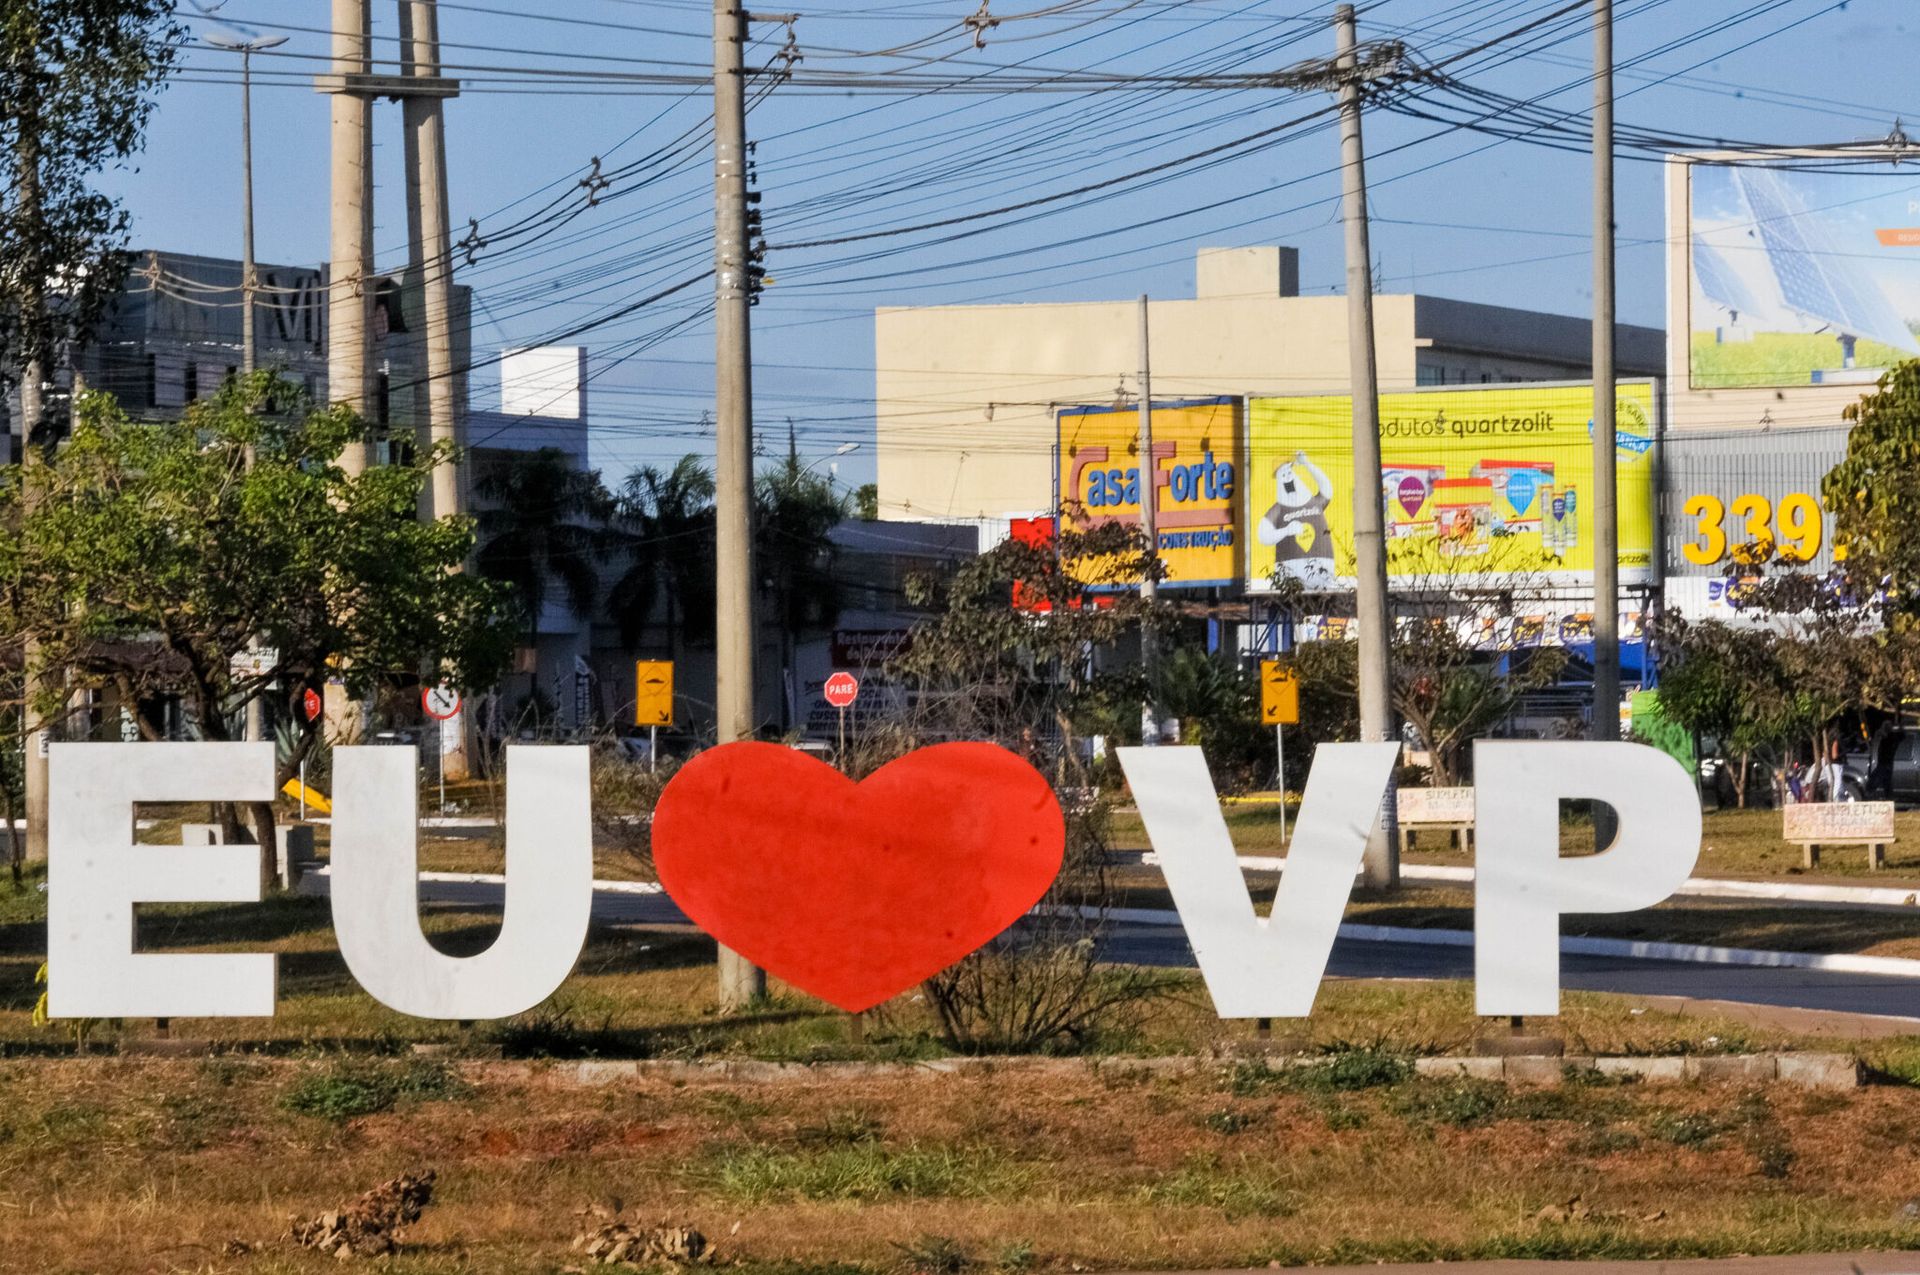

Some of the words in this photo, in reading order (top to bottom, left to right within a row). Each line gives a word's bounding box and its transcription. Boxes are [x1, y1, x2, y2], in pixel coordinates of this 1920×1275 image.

[1380, 418, 1445, 438] odutos
[1452, 411, 1555, 439] quartzolit
[1069, 446, 1141, 528] Casa
[1151, 441, 1235, 514] Forte
[829, 683, 853, 695] PARE
[48, 741, 593, 1021] EU
[1116, 739, 1703, 1018] VP
